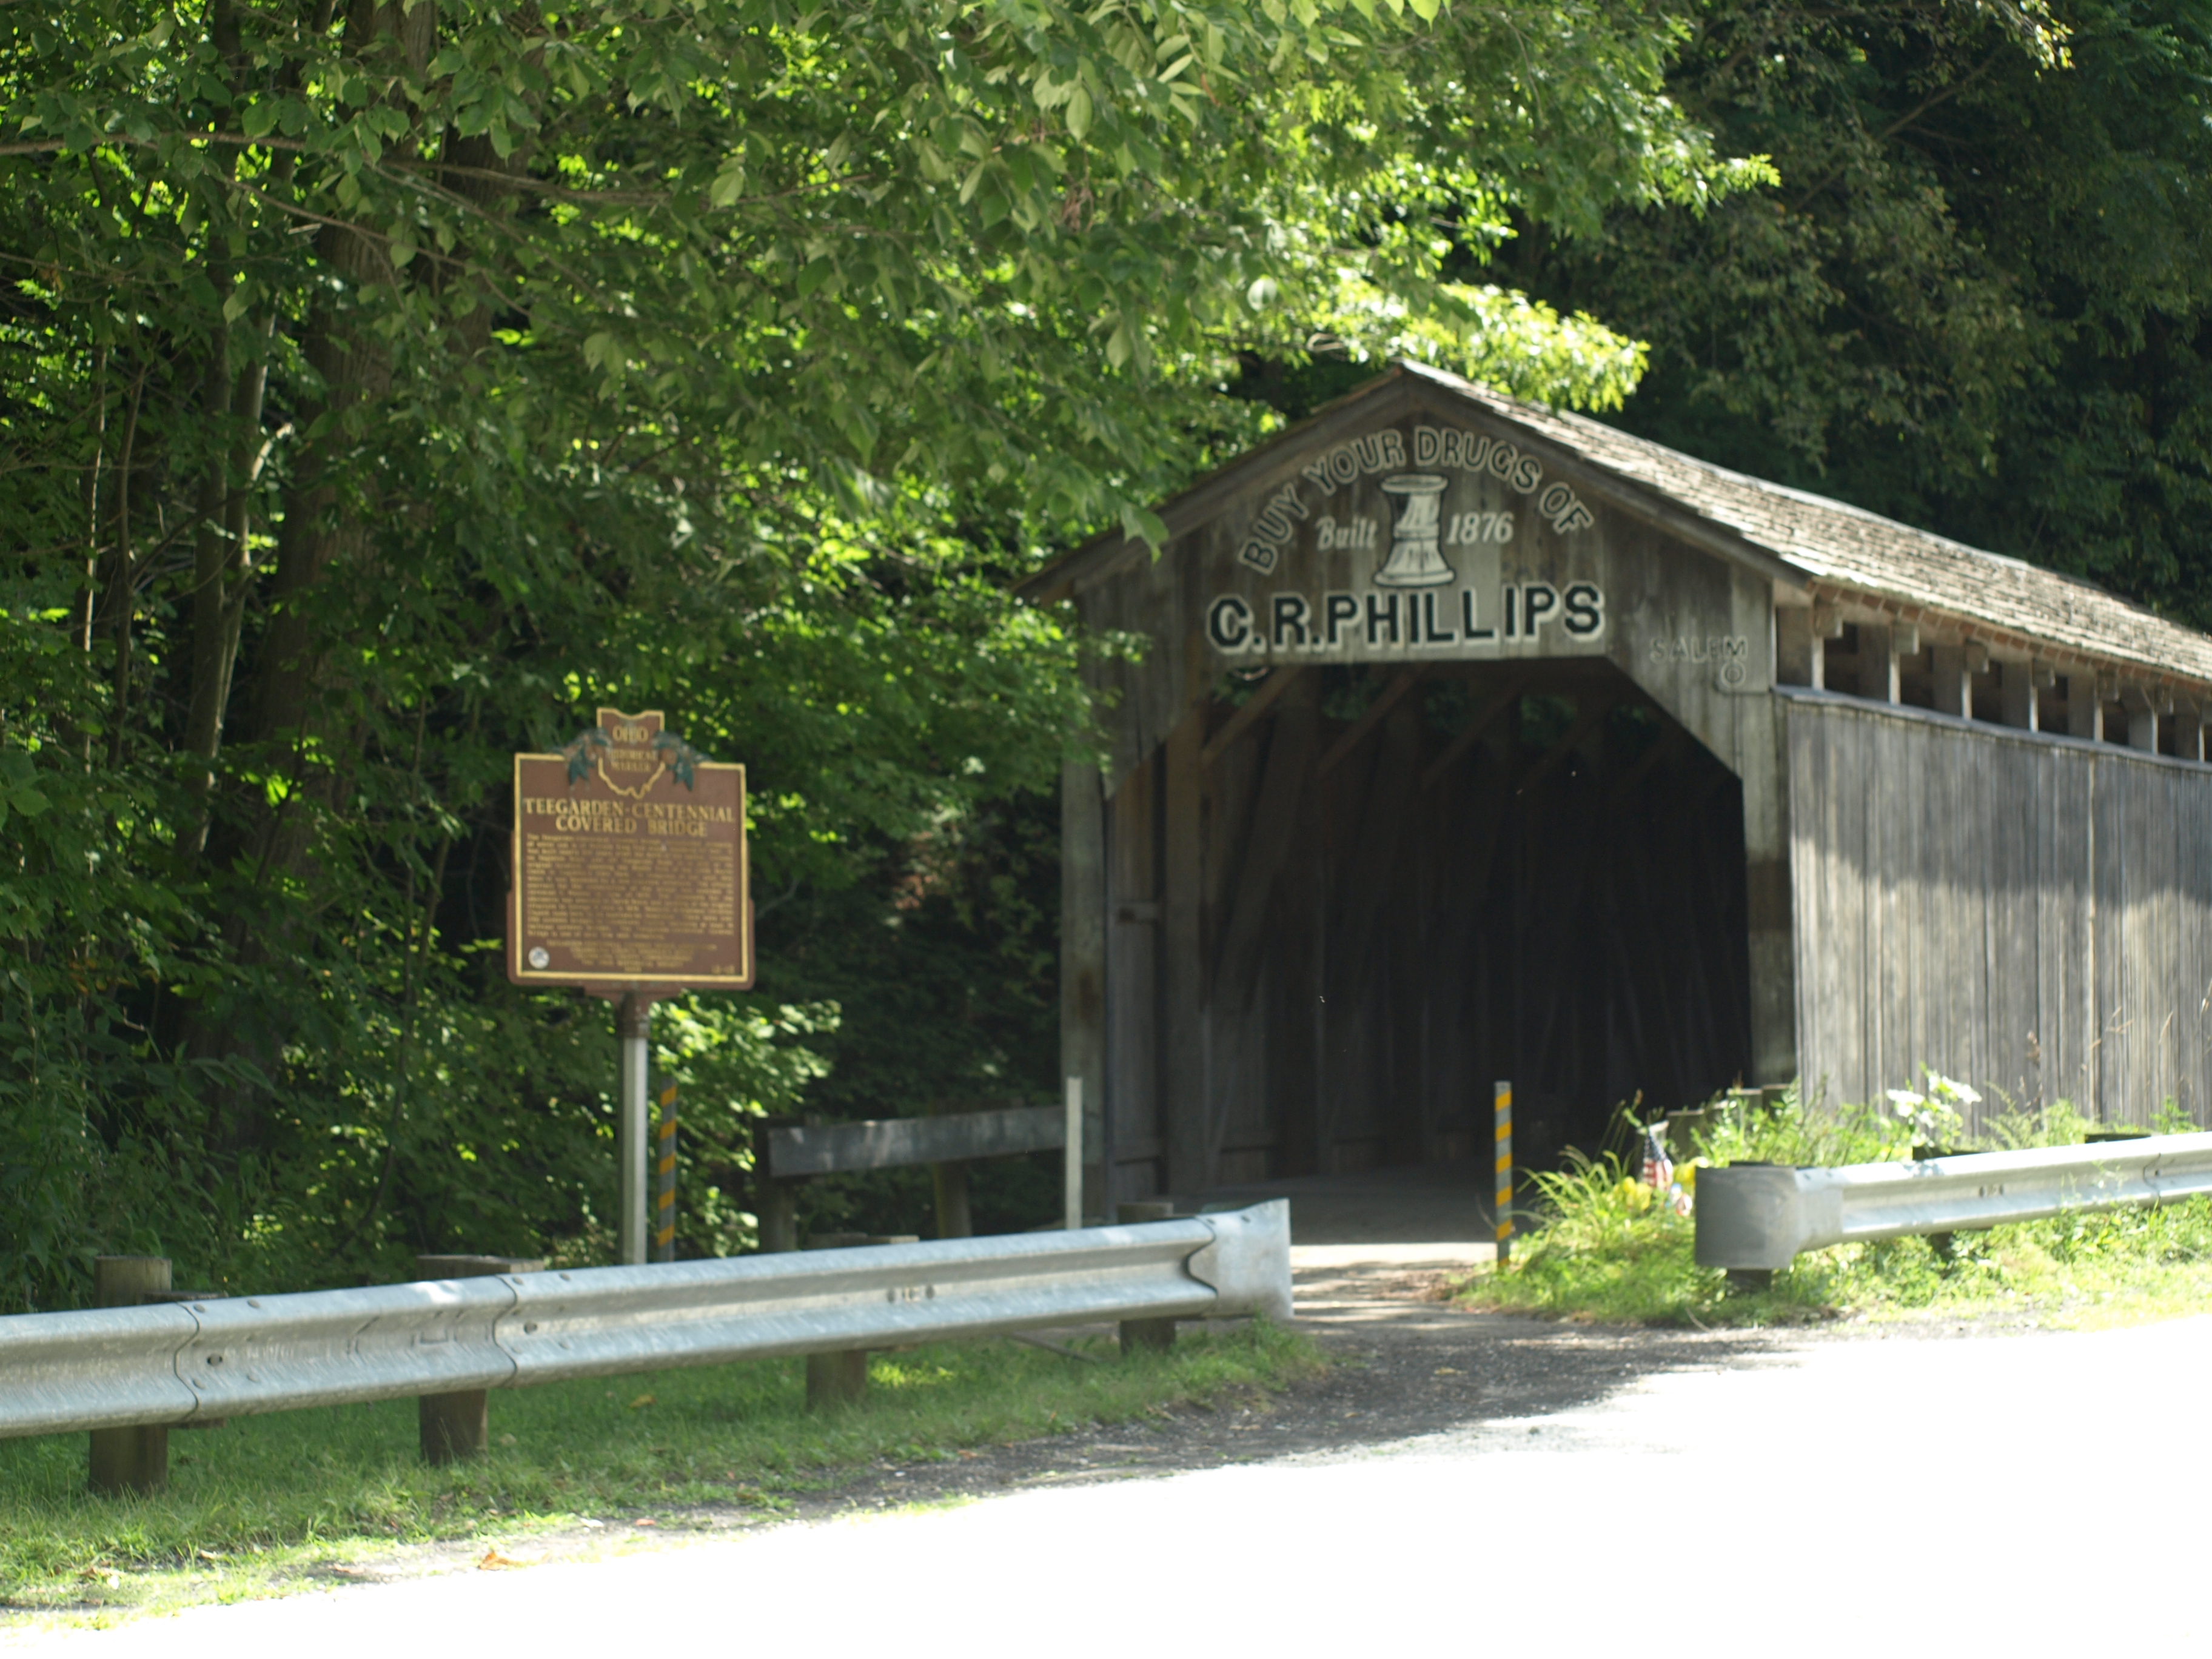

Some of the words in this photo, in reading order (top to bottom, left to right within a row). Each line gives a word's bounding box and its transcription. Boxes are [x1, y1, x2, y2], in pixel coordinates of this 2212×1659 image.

[1238, 483, 1309, 575] BUY
[1302, 429, 1406, 496] YOUR
[1413, 426, 1543, 495] DRUGS
[1540, 482, 1595, 535] OF
[1315, 515, 1379, 551] Built
[1446, 511, 1515, 545] 1876
[1649, 635, 1749, 665] SALEM
[612, 725, 649, 743] OHIO
[555, 816, 637, 834] COVERED
[648, 820, 708, 837] BRIDGE
